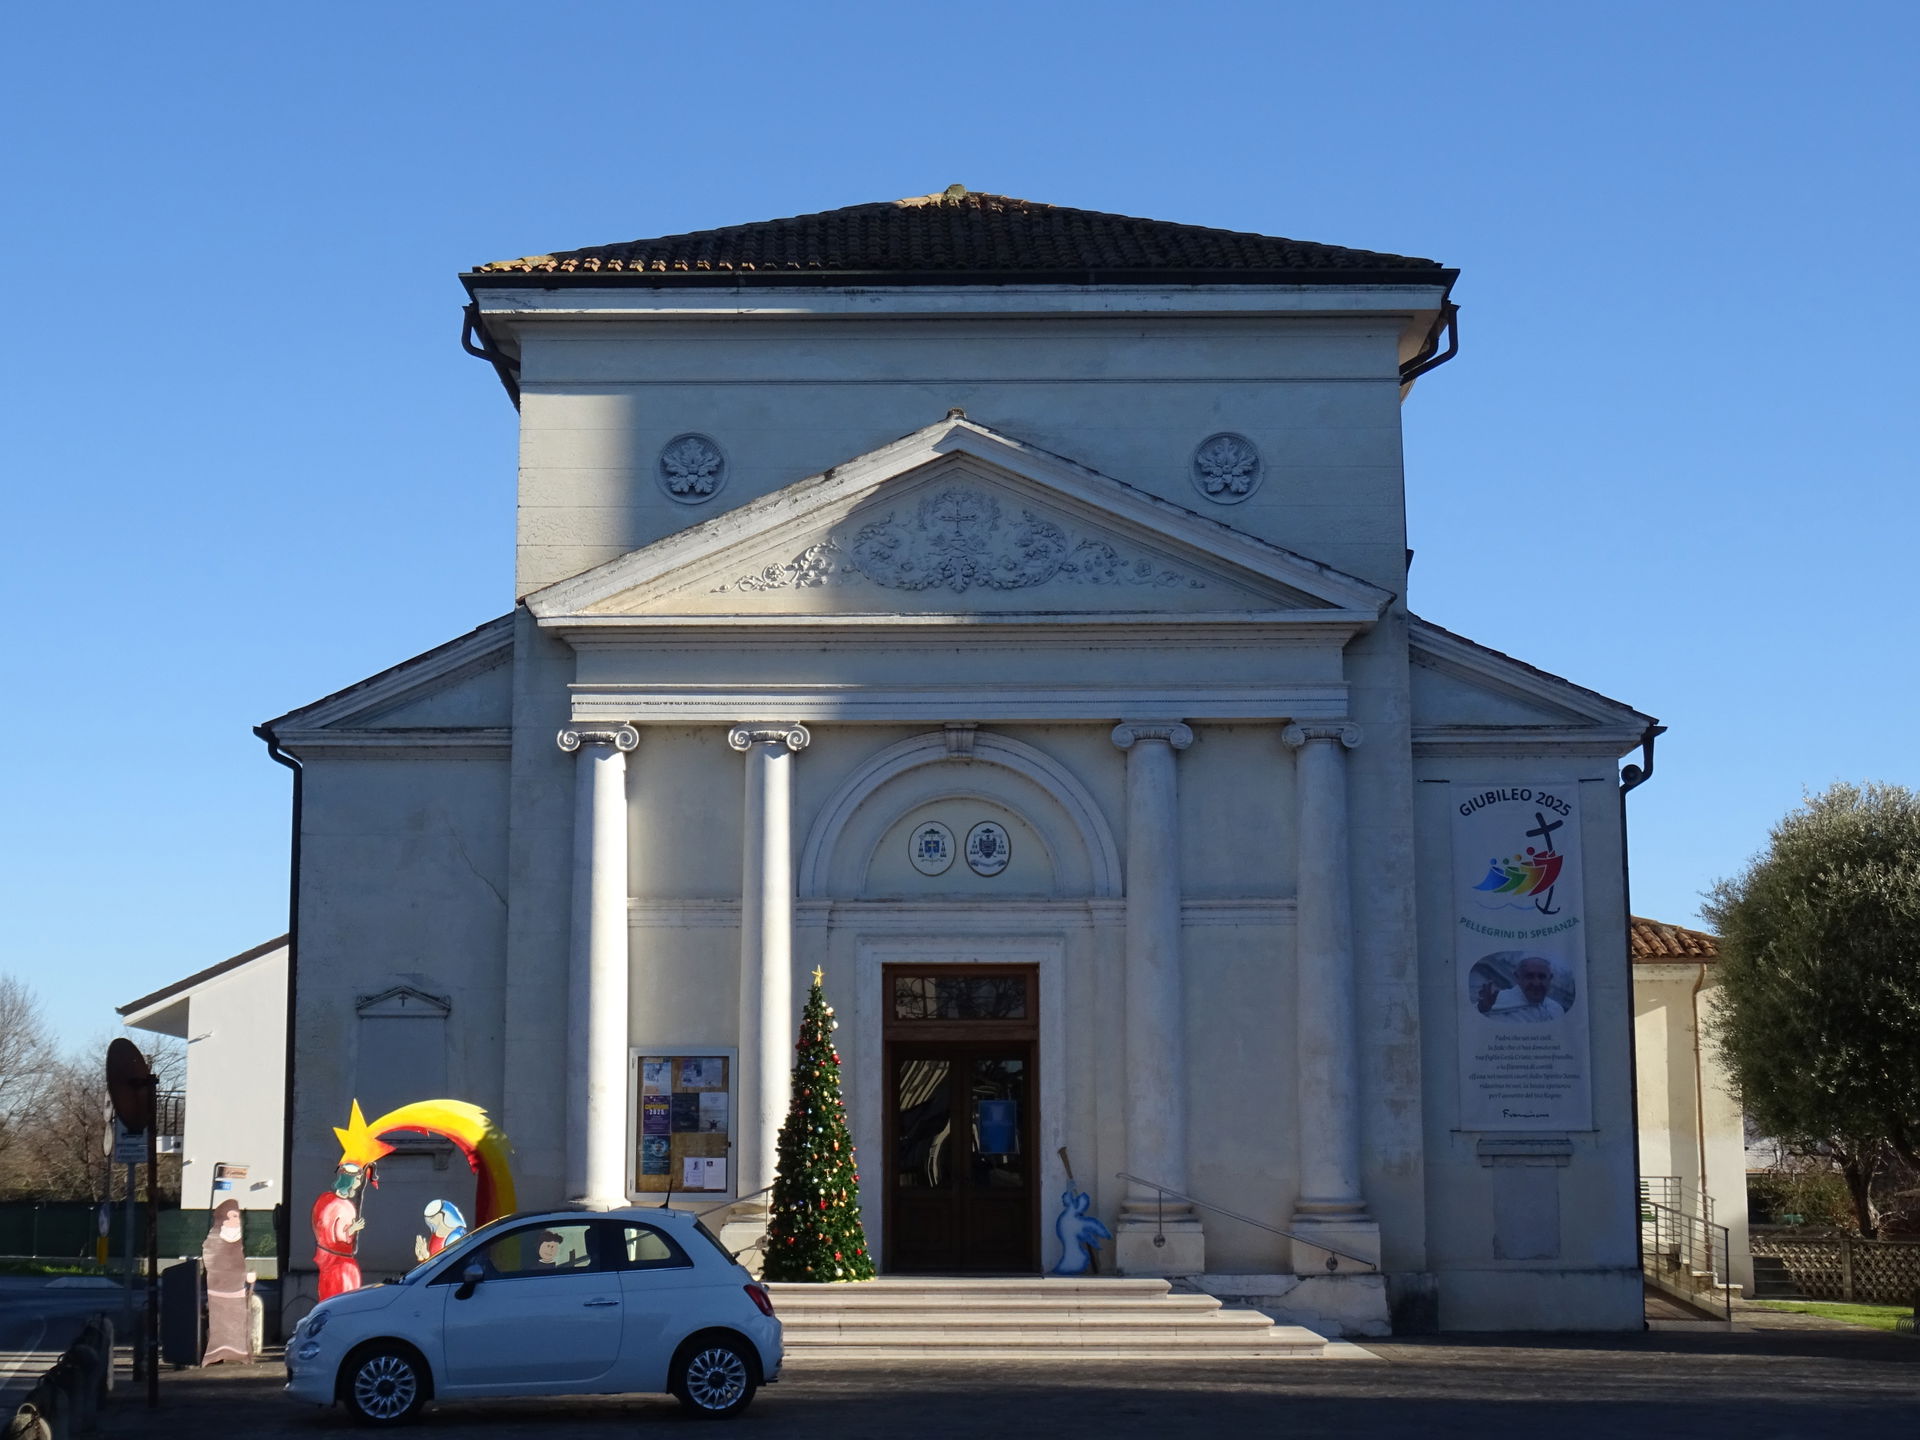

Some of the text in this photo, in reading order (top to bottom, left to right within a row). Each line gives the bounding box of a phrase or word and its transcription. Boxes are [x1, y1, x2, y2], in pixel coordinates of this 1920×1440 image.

[1459, 788, 1572, 816] GIUBILEO 2025
[1459, 916, 1580, 940] PELLEGRINI DI SPERANZA
